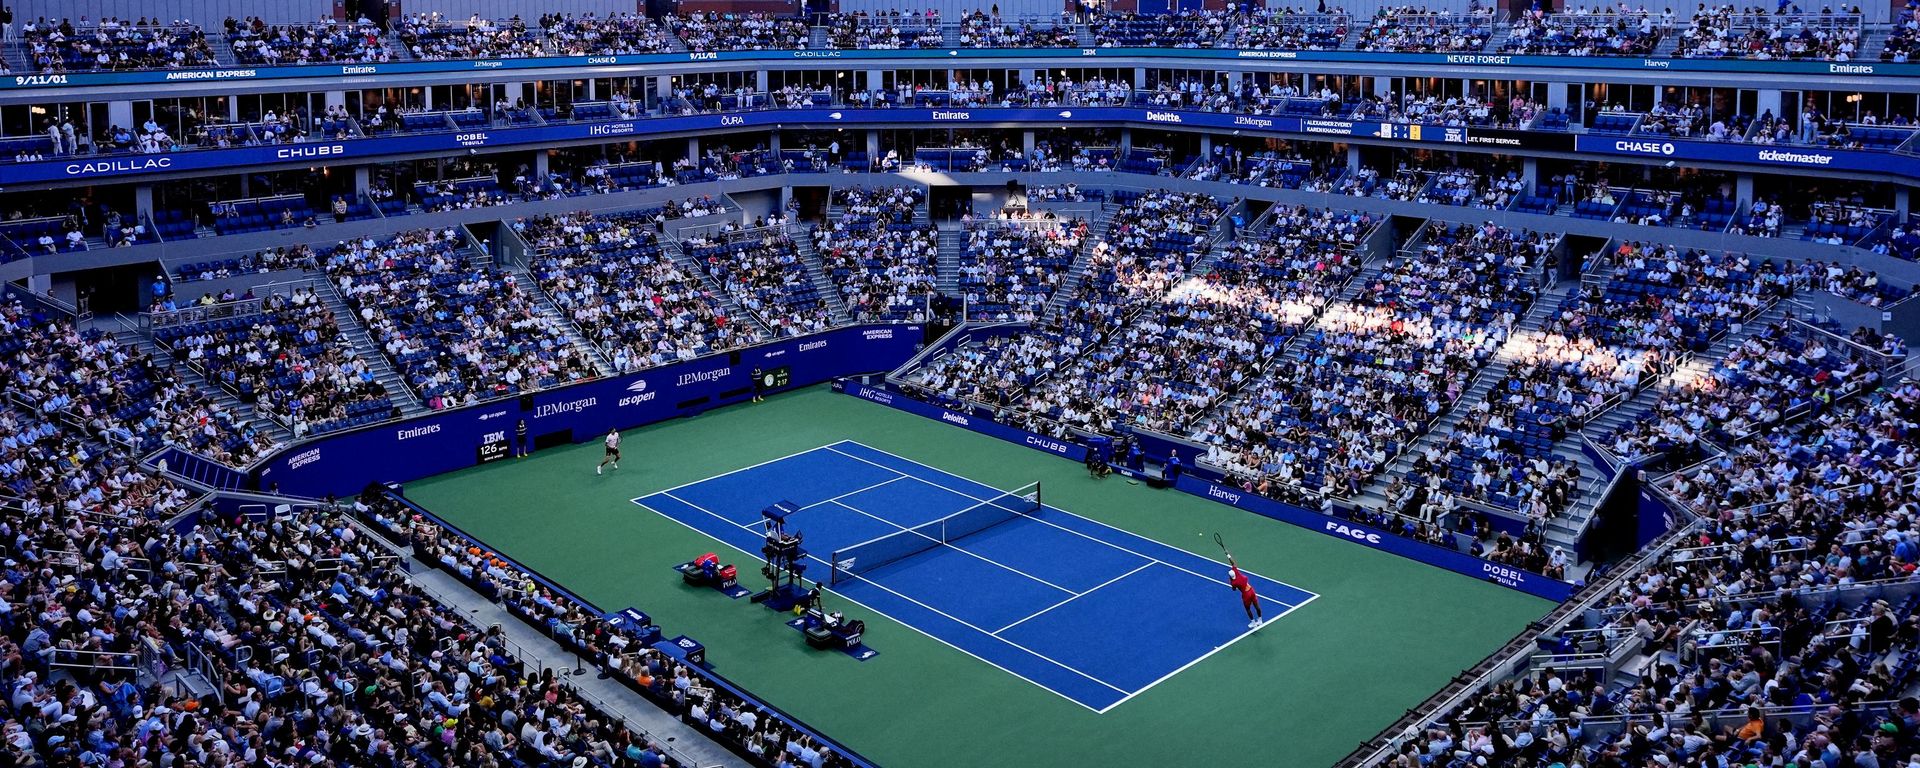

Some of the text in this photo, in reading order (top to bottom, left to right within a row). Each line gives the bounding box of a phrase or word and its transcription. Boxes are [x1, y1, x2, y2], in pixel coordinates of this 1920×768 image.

[690, 51, 718, 59] 9/11/01
[1447, 55, 1512, 64] NEVER FORGET
[342, 65, 377, 74] Emirates
[1644, 59, 1670, 69] Harvey
[1829, 64, 1874, 74] Emirates
[15, 75, 68, 85] 9/11/01
[166, 69, 257, 79] AMERICAN EXPRESS
[932, 110, 970, 120] Emirates
[1146, 112, 1182, 123] Deloitte.
[590, 124, 610, 135] IHG
[456, 133, 488, 142] DOBEL
[1444, 133, 1463, 143] IBM
[1495, 138, 1521, 146] SERVICE.
[277, 145, 344, 159] CHUBB
[1615, 140, 1661, 153] CHASE
[1758, 149, 1833, 165] ticketmaster
[66, 157, 171, 175] CADILLAC
[798, 339, 828, 352] Emirates
[618, 389, 656, 407] us open
[859, 387, 875, 399] IHG
[943, 410, 969, 426] Deloitte.
[397, 423, 441, 441] Emirates
[483, 430, 505, 445] IBM
[480, 443, 498, 456] 126
[1026, 435, 1067, 453] CHUBB
[287, 447, 321, 466] AMERICAN
[291, 453, 321, 470] EXPRESS
[1208, 484, 1241, 505] Harvey
[1483, 563, 1525, 582] DOBEL
